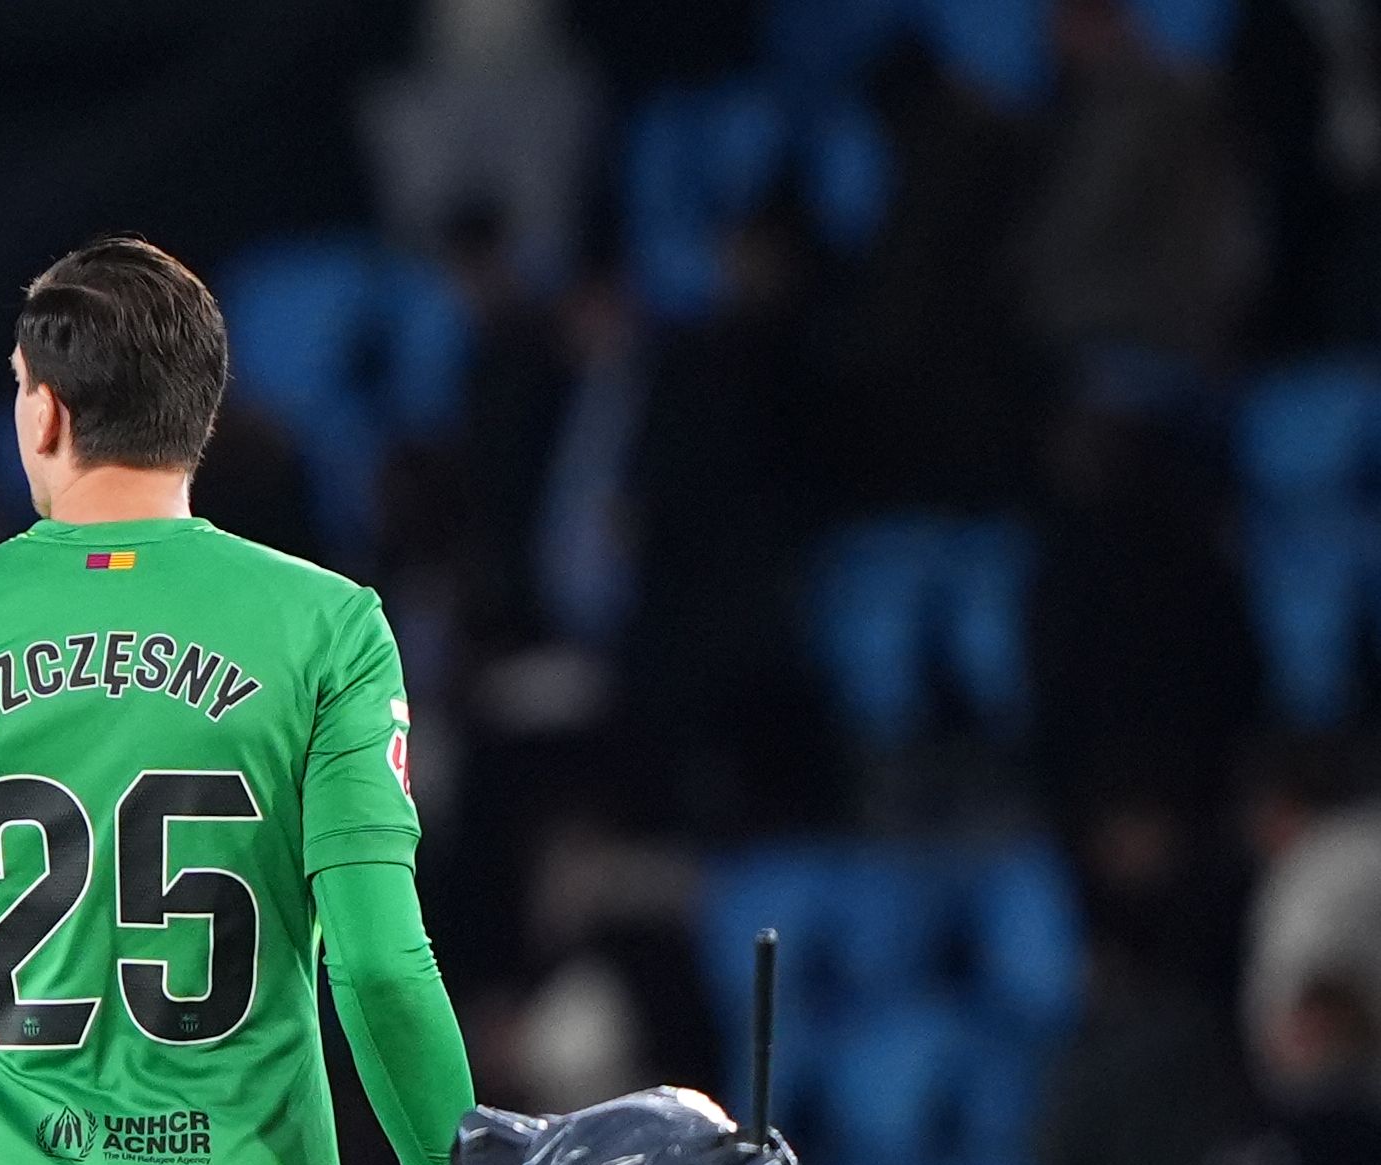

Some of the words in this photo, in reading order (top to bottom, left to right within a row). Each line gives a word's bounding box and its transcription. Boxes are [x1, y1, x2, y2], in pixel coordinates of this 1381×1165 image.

[103, 1111, 210, 1135] UNHCR
[102, 1132, 211, 1155] ACNUR
[103, 1151, 119, 1161] The
[138, 1155, 175, 1165] Refugee
[177, 1155, 211, 1165] Agency
